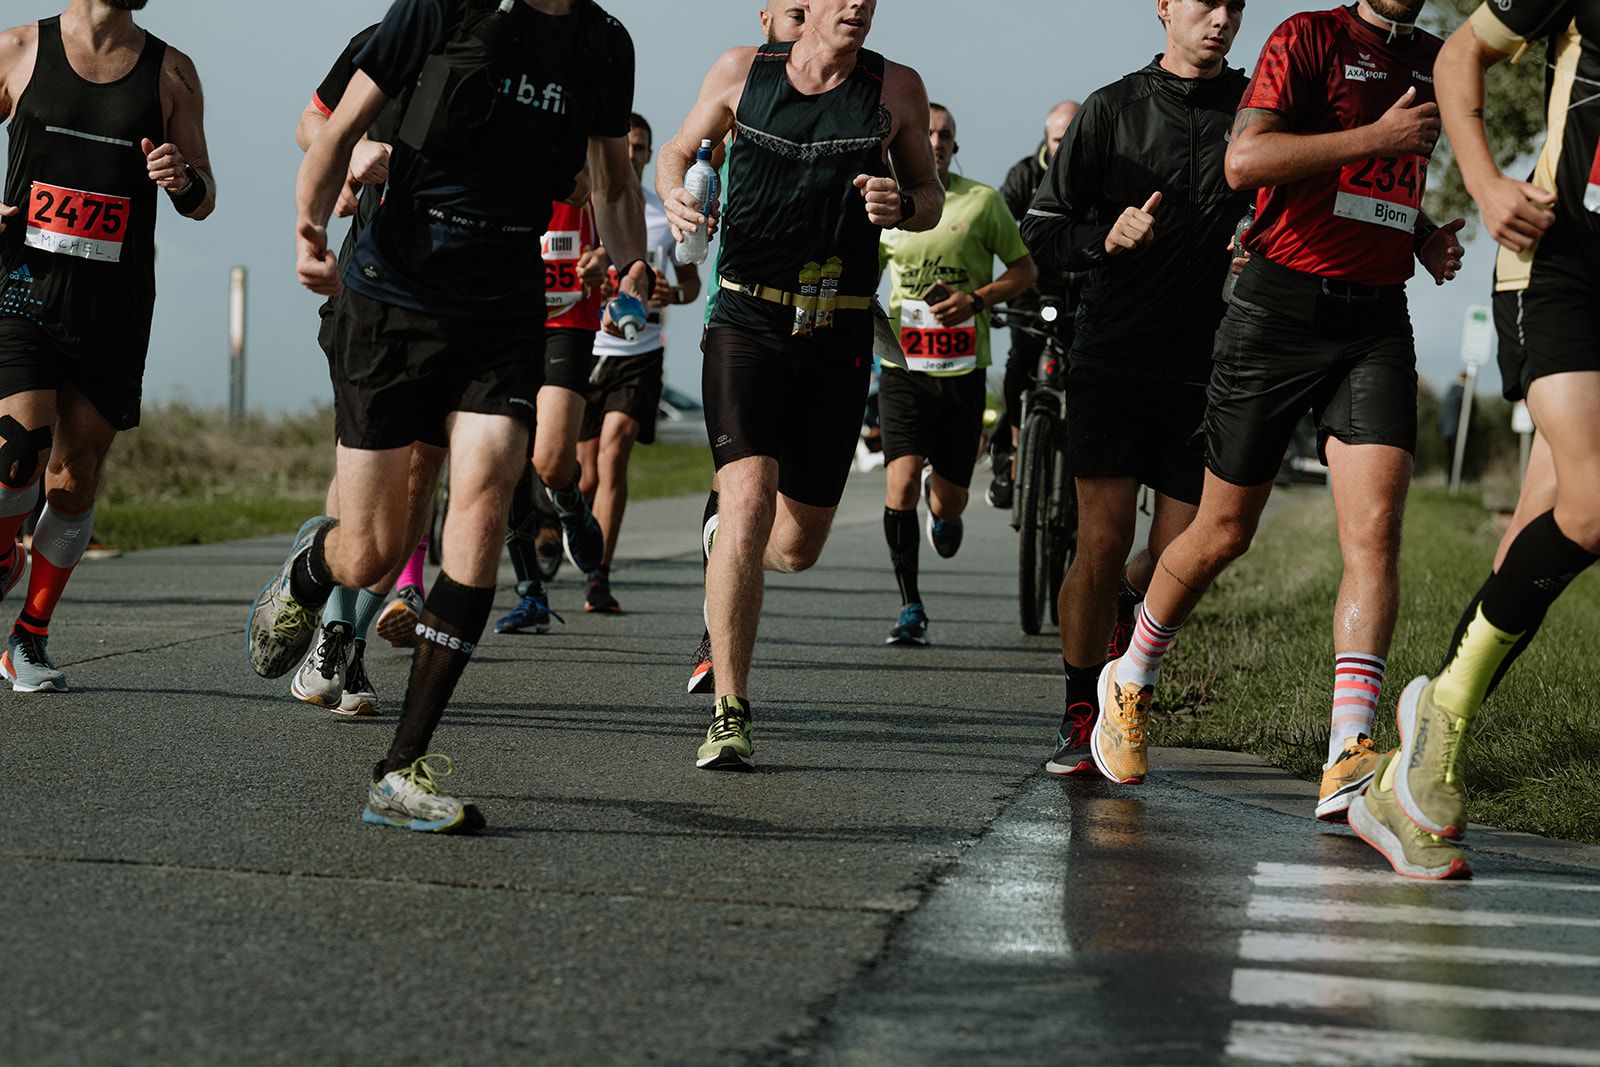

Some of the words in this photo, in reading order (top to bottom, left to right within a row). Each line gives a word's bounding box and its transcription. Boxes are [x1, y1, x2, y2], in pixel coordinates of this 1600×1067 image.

[34, 190, 123, 235] 2475
[1374, 203, 1408, 224] Bjorn
[906, 330, 971, 355] 2198
[415, 622, 474, 653] PRESS
